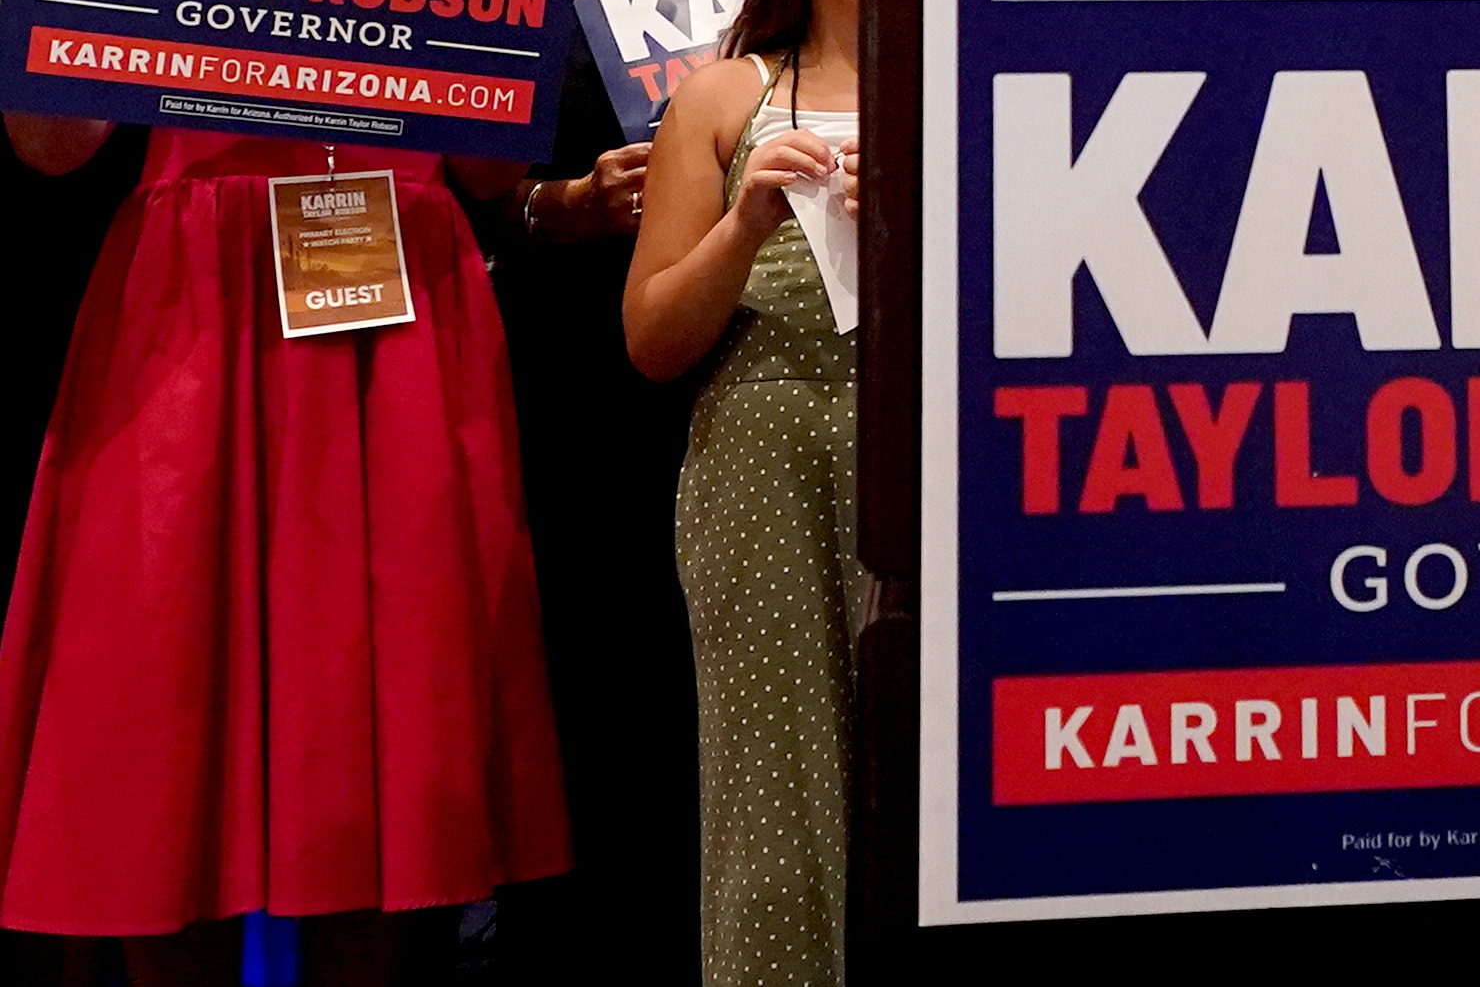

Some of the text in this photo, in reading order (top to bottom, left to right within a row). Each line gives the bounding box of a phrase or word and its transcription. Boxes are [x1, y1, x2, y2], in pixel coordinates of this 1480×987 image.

[176, 0, 413, 50] GOVERNOR
[49, 39, 515, 113] KARRINFORARIZONA.COM
[165, 99, 183, 110] Paid
[301, 191, 366, 211] KARRIN
[305, 284, 384, 310] GUEST
[1342, 832, 1382, 850] Paid
[1387, 832, 1413, 848] for
[1419, 830, 1440, 851] by
